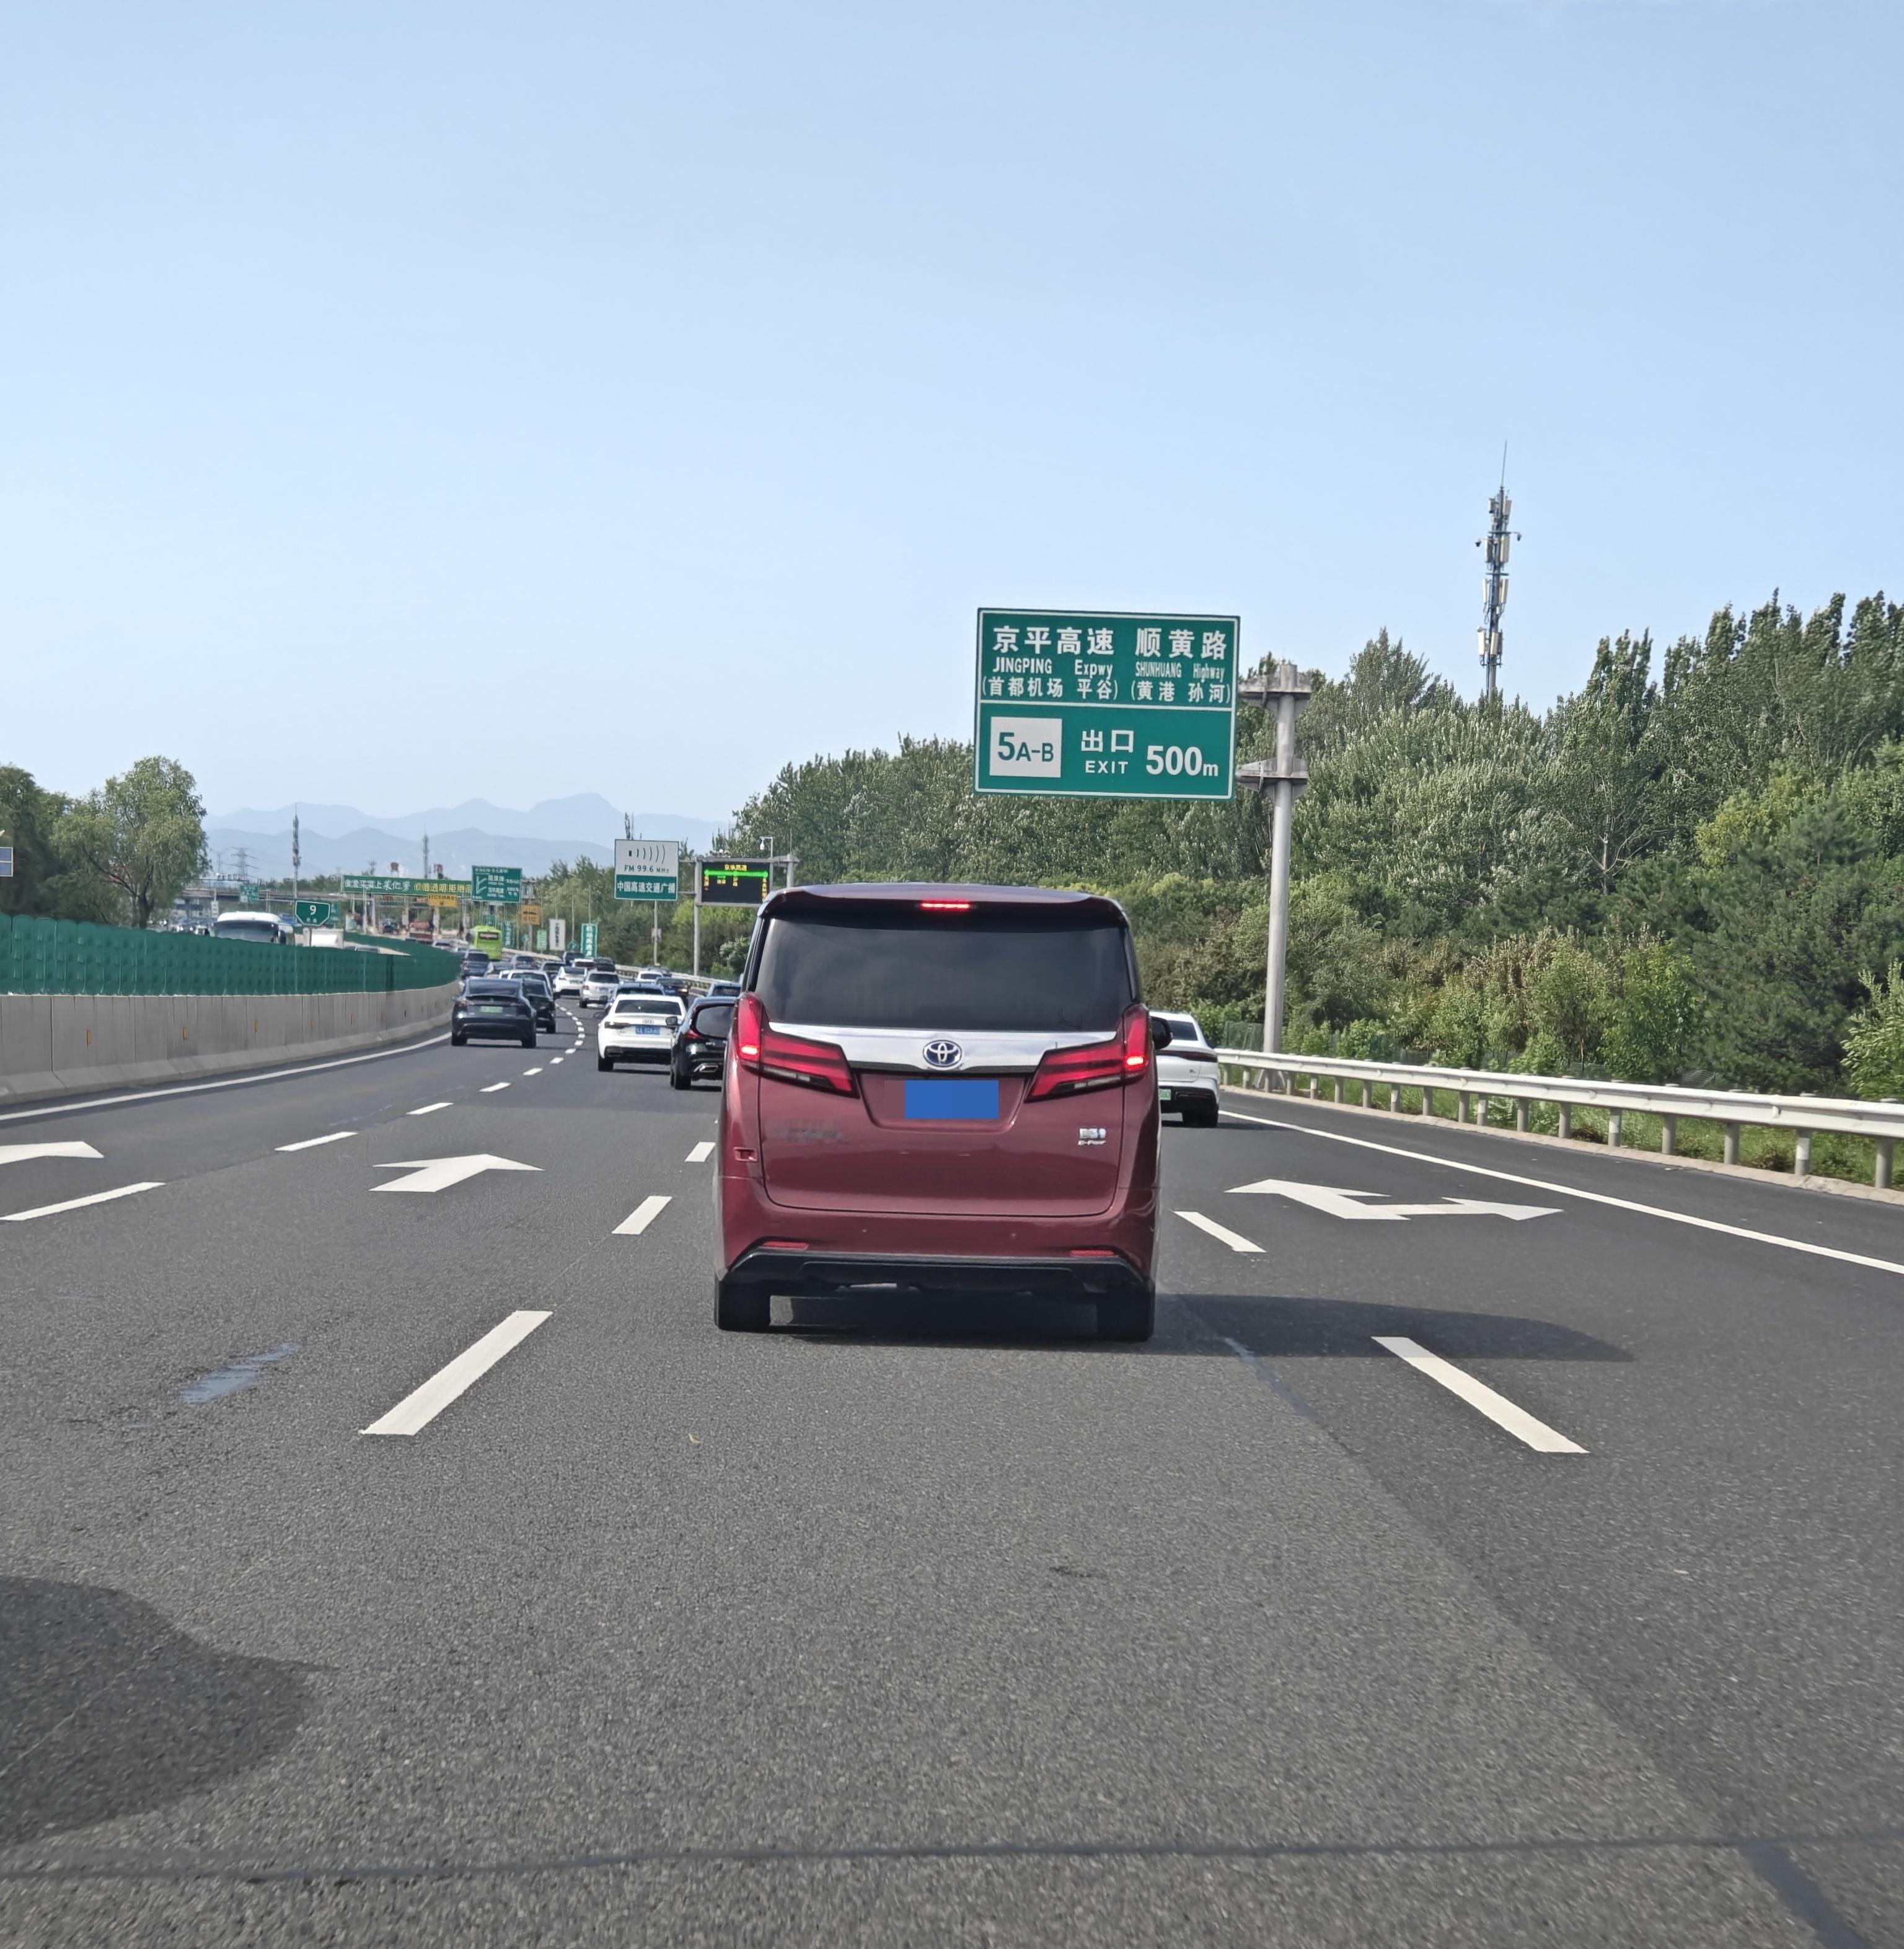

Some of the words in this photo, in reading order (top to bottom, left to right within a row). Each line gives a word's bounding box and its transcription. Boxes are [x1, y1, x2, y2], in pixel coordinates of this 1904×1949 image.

[992, 625, 1114, 655] 京平高速
[1135, 627, 1227, 660] 顺黄路
[992, 657, 1052, 674] JINGPING
[1075, 660, 1113, 680] Expwy
[1135, 661, 1183, 678] SHUNHUANG
[1193, 664, 1225, 683] Highway
[997, 731, 1055, 763] 5A-B
[1081, 729, 1135, 753] 出口
[1085, 760, 1129, 774] EXIT
[1145, 745, 1219, 777] 500m
[637, 865, 654, 873] 99.6
[617, 881, 676, 894] 中国高速交通广播
[309, 905, 317, 916] 9
